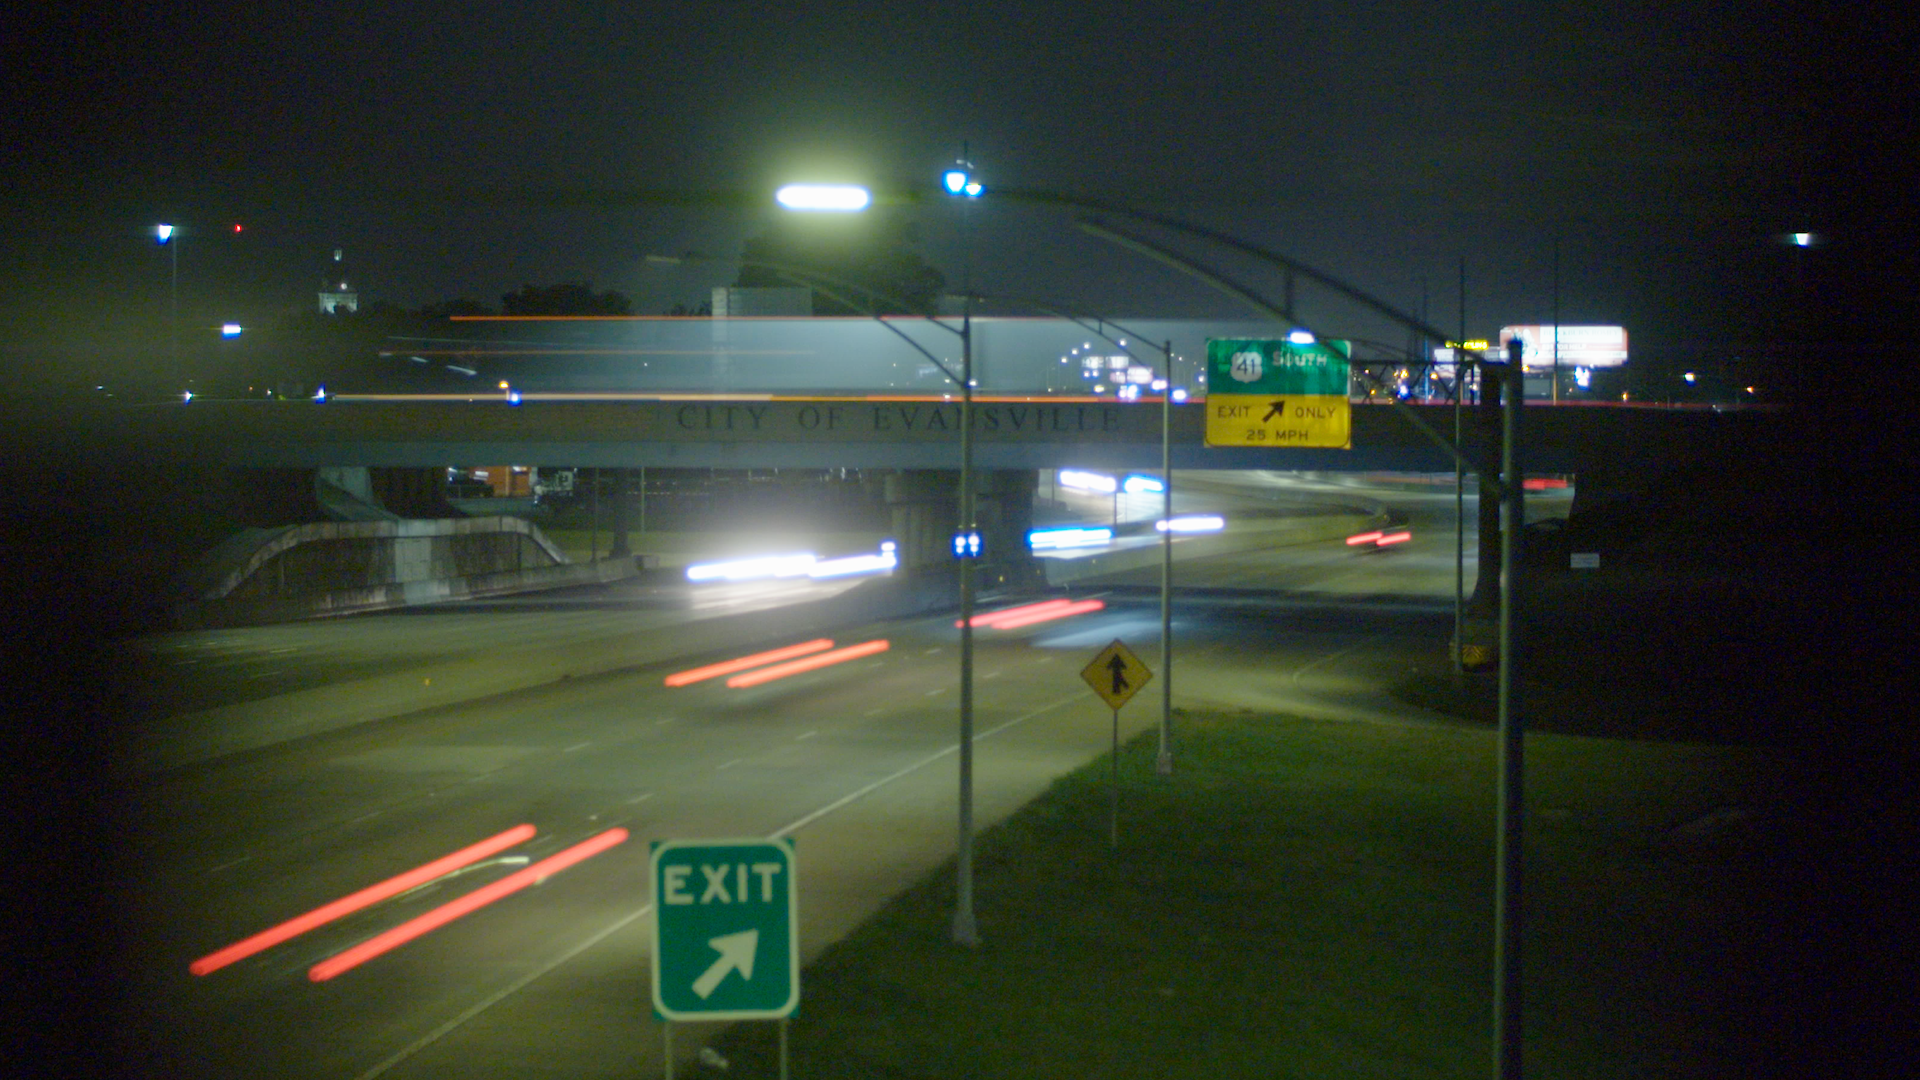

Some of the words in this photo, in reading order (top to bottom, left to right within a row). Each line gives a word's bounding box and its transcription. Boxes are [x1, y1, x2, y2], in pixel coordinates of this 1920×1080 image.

[1237, 358, 1256, 375] 41
[1272, 351, 1327, 366] SOUTH
[676, 404, 768, 430] CITY
[799, 405, 845, 430] OF
[873, 406, 1121, 431] EVANSVILLE
[1218, 406, 1250, 418] EXIT
[1295, 406, 1336, 418] ONLY
[1246, 429, 1266, 441] 25
[1276, 430, 1309, 441] MPH
[664, 862, 782, 905] EXIT
